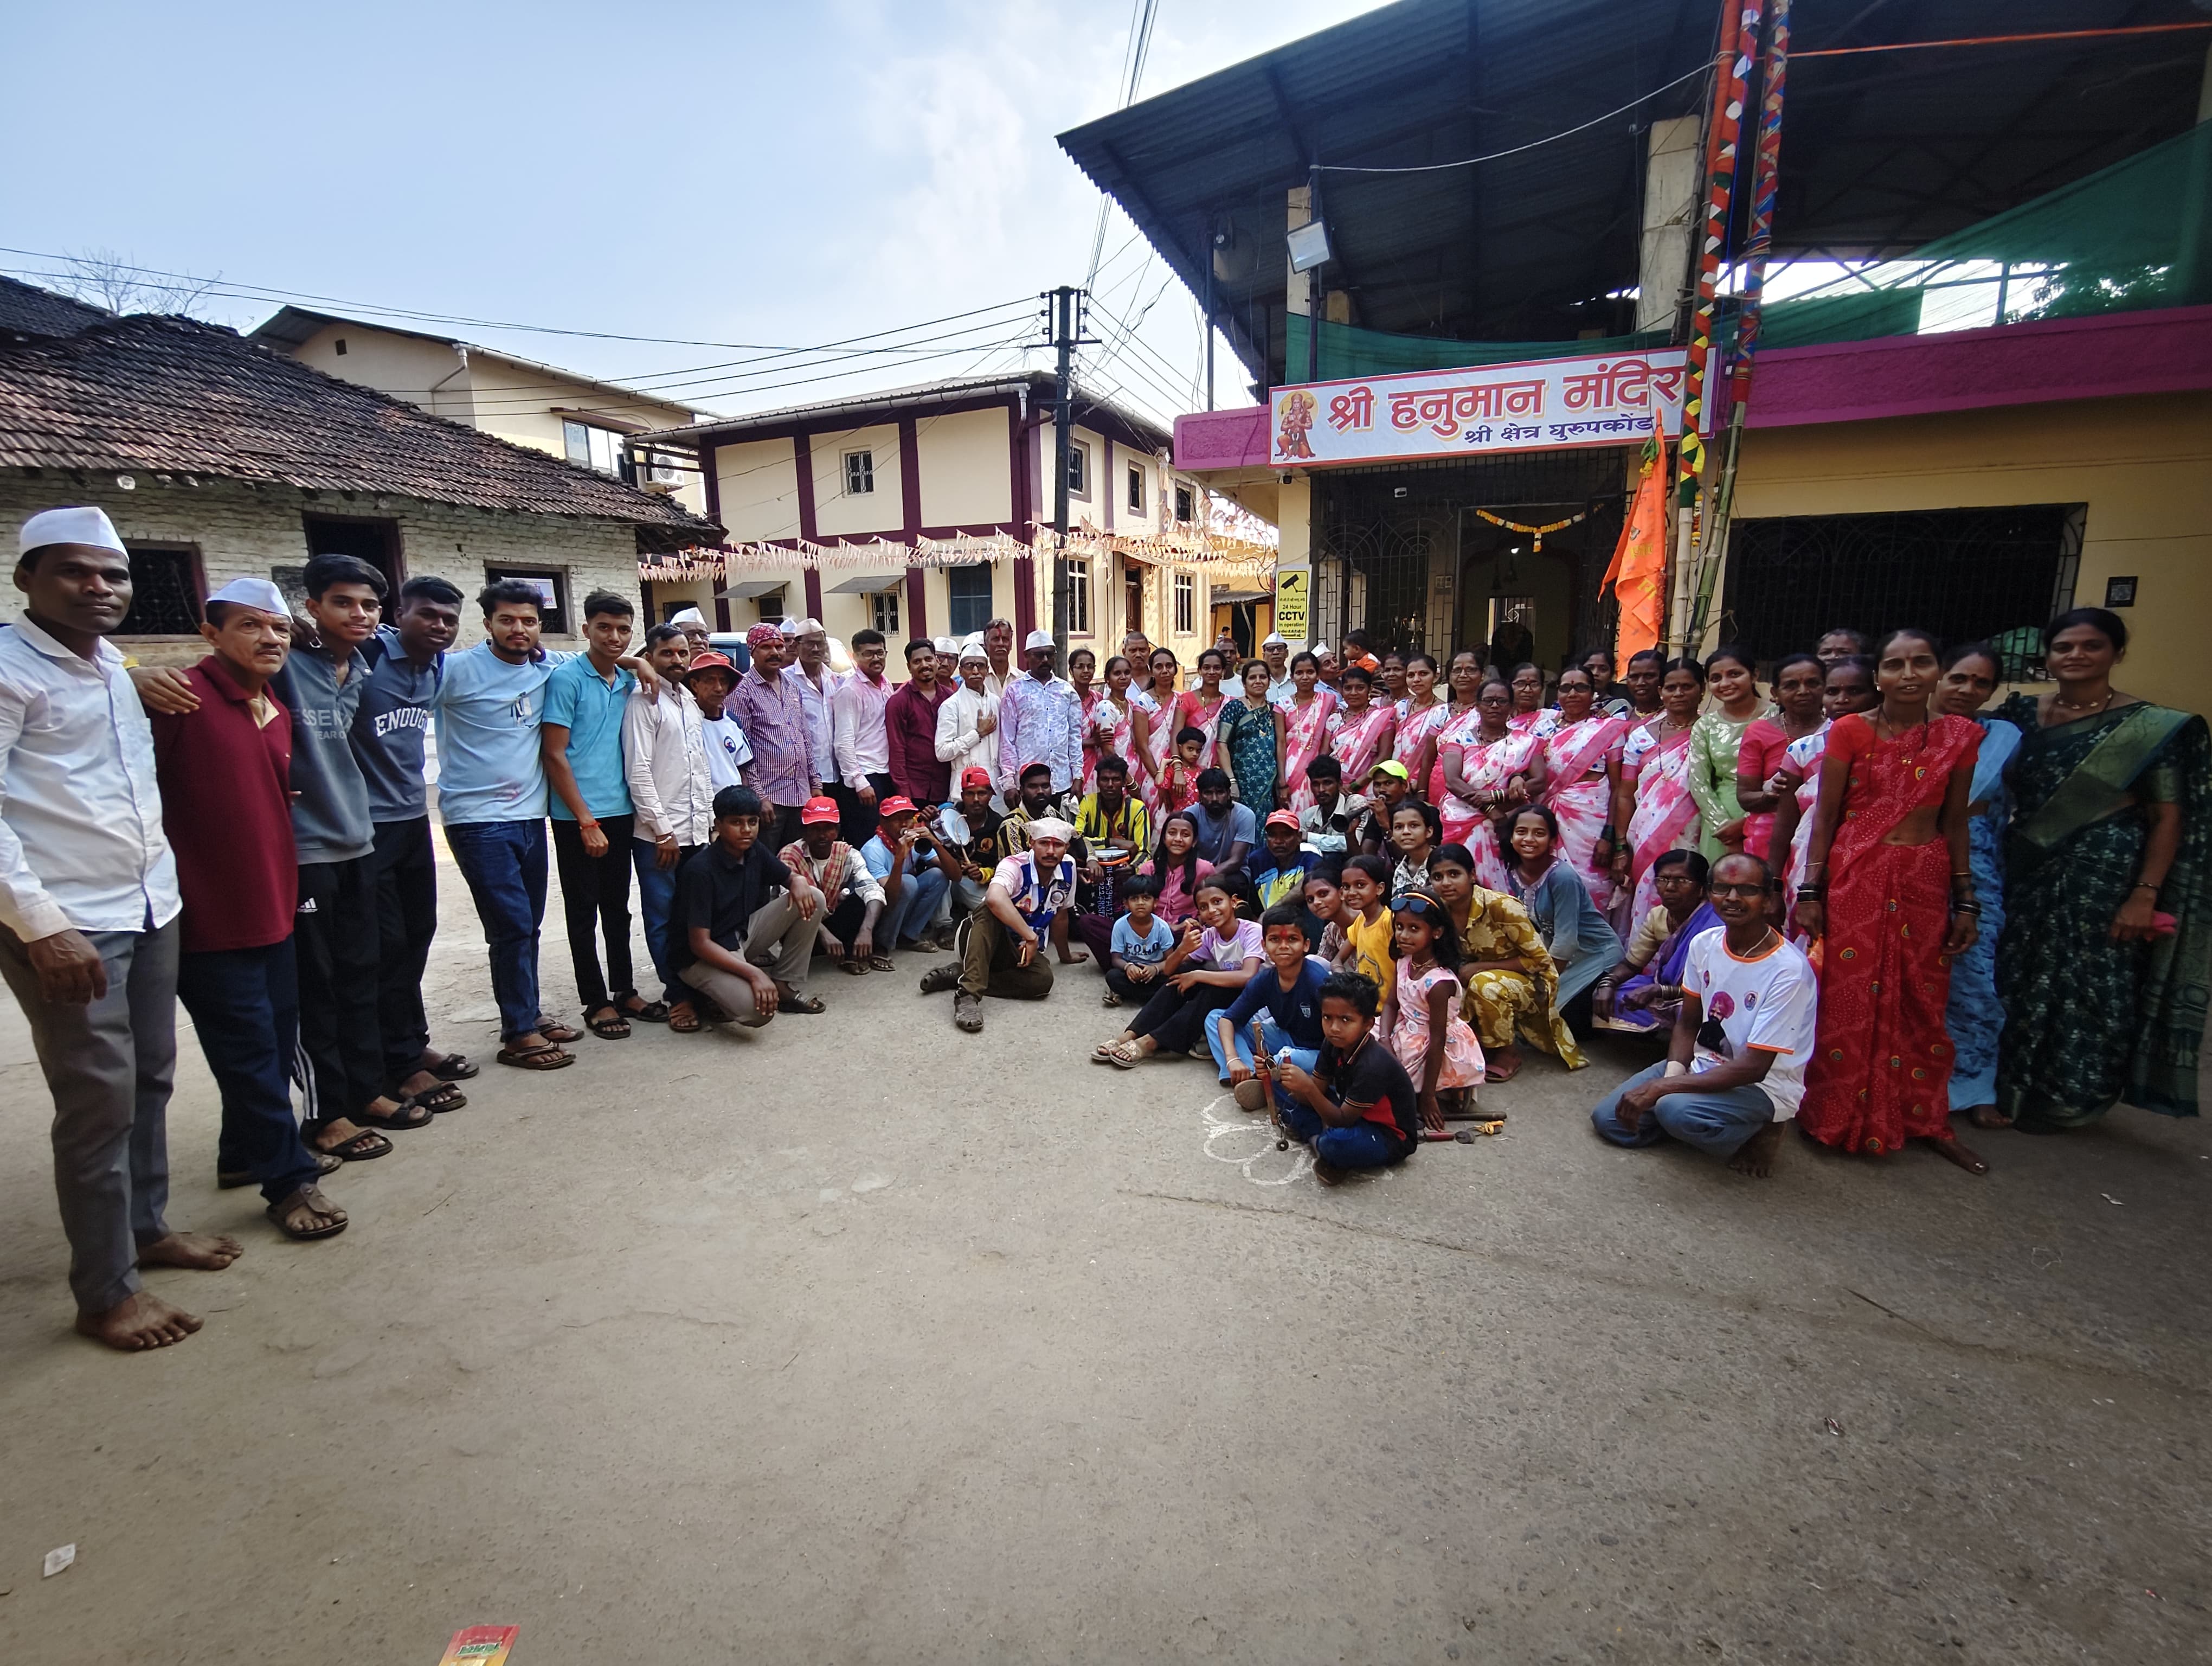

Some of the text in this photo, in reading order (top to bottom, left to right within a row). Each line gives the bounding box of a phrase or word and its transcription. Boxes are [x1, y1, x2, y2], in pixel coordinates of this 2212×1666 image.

[1327, 358, 1686, 438] श्री हनुमान मंदिर
[1464, 425, 1493, 443] श्री
[1501, 422, 1541, 441] क्षेत्र
[1279, 611, 1304, 620] CCTV
